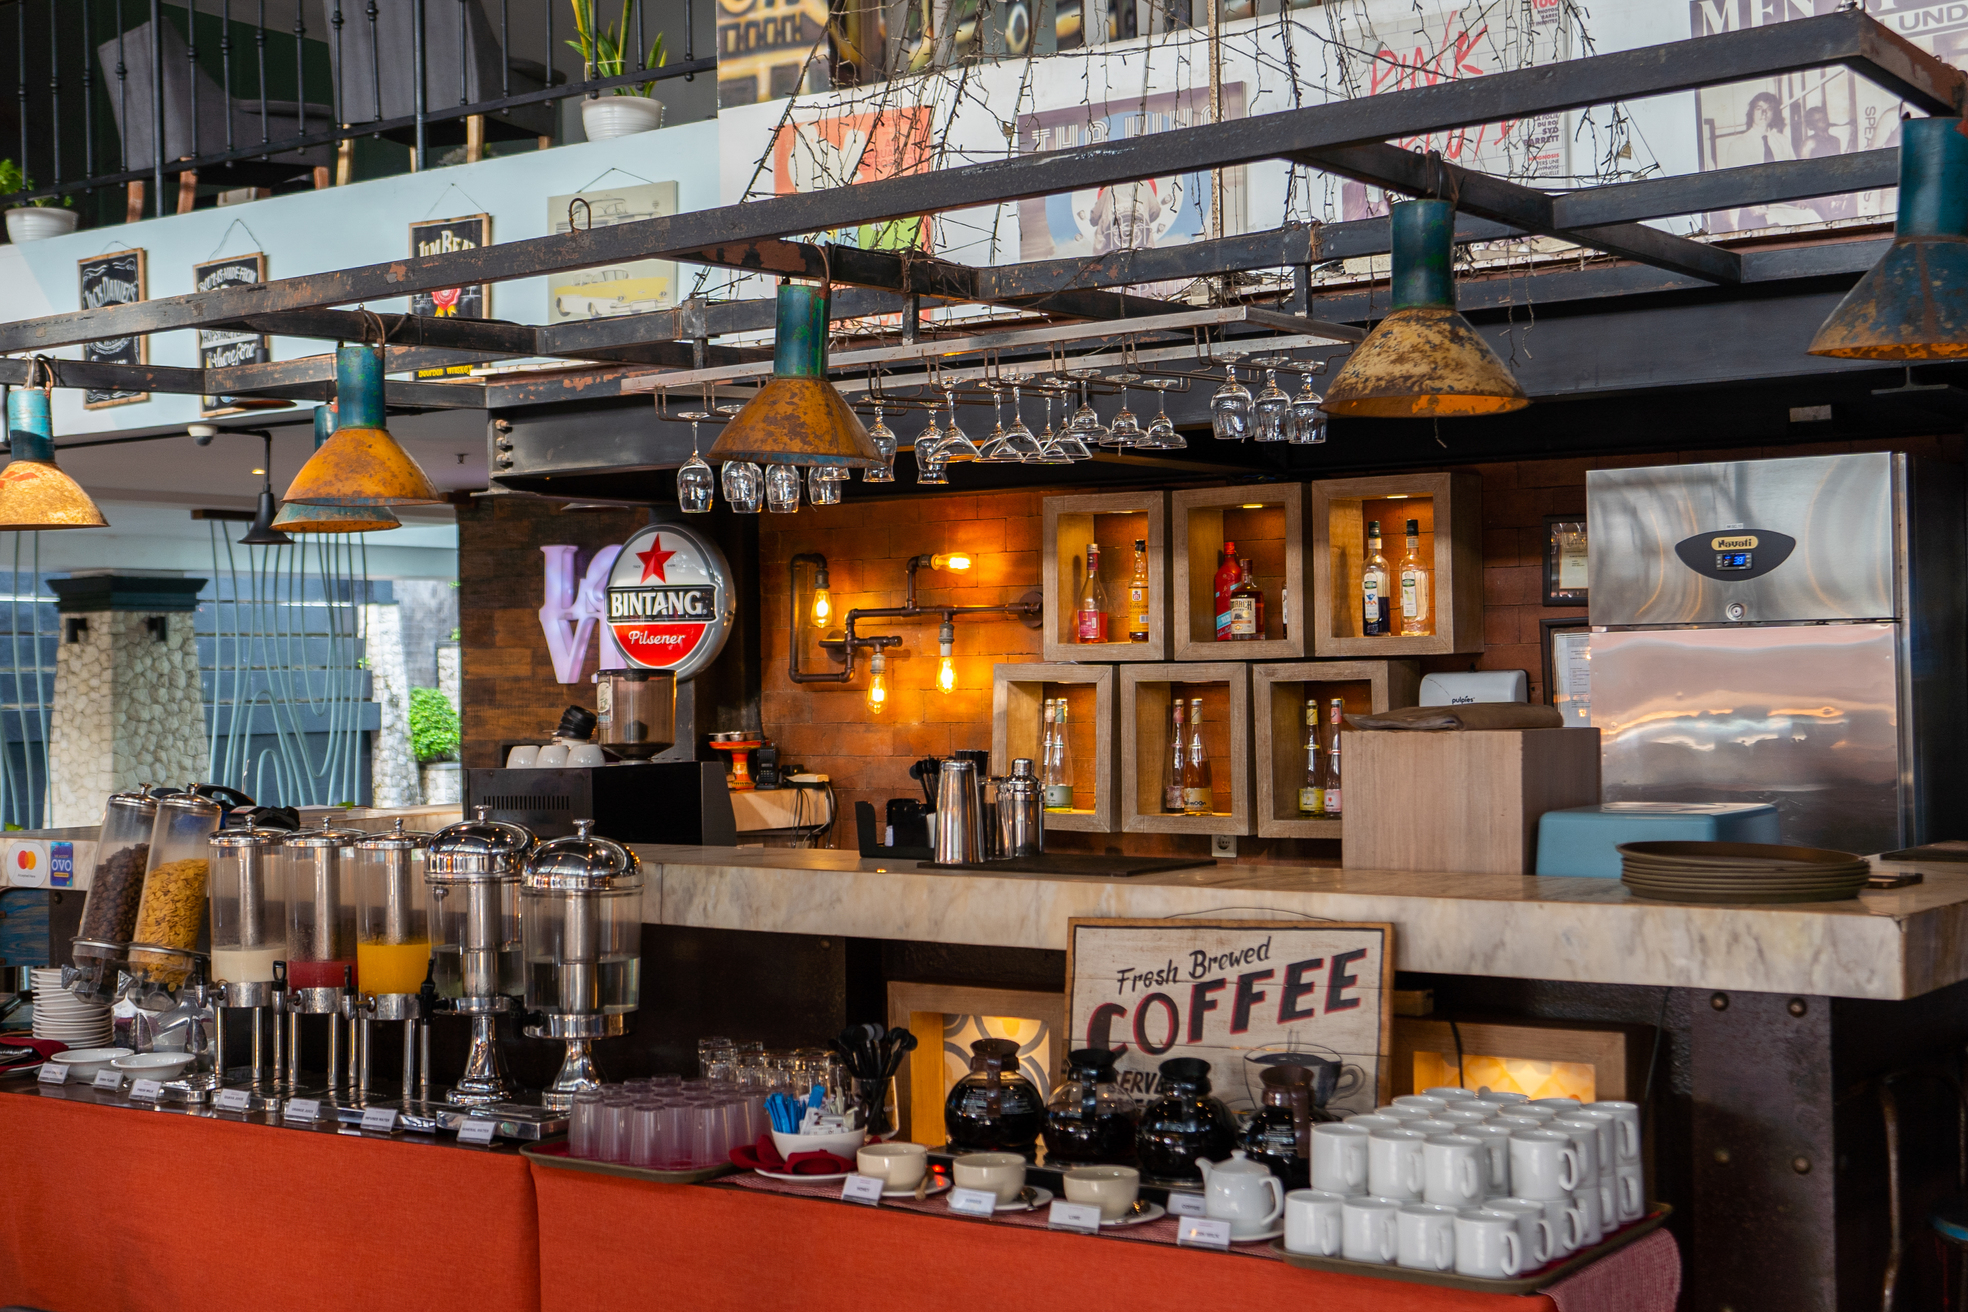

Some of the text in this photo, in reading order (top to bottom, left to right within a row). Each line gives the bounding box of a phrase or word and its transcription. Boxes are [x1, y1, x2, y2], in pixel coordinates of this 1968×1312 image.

[1523, 134, 1560, 146] BARRETT
[1542, 126, 1559, 135] SYD
[212, 343, 256, 368] therefore
[610, 591, 702, 617] BINTANG
[628, 630, 686, 646] Pilsener
[51, 859, 72, 872] OVO
[1116, 935, 1272, 996] Fresh Brewed
[1086, 948, 1368, 1060] COFFEE
